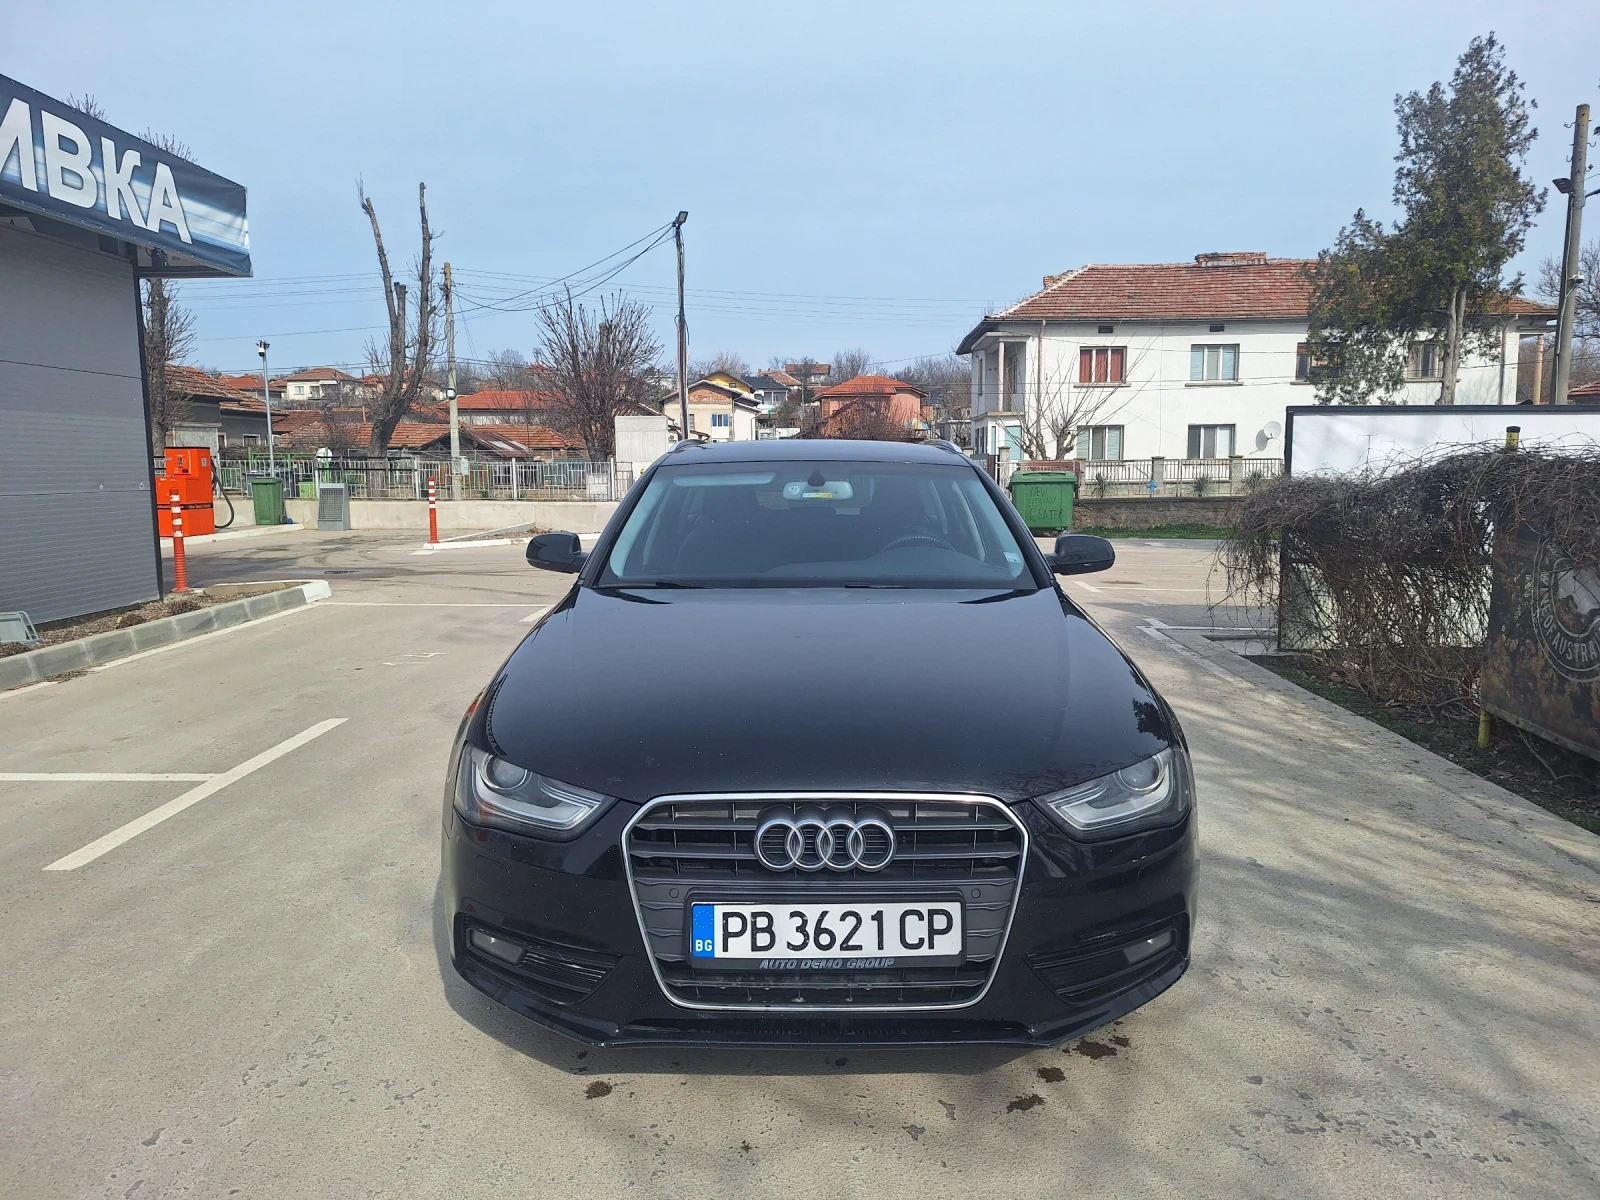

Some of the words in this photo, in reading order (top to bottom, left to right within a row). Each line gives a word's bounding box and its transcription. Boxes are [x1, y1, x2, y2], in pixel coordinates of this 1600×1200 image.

[722, 911, 776, 953] PB
[786, 910, 884, 952] 3621
[899, 908, 953, 950] CP
[695, 939, 713, 952] BG
[759, 959, 798, 969] AUTO
[800, 959, 842, 969] DEMO
[846, 957, 896, 969] GROUP
